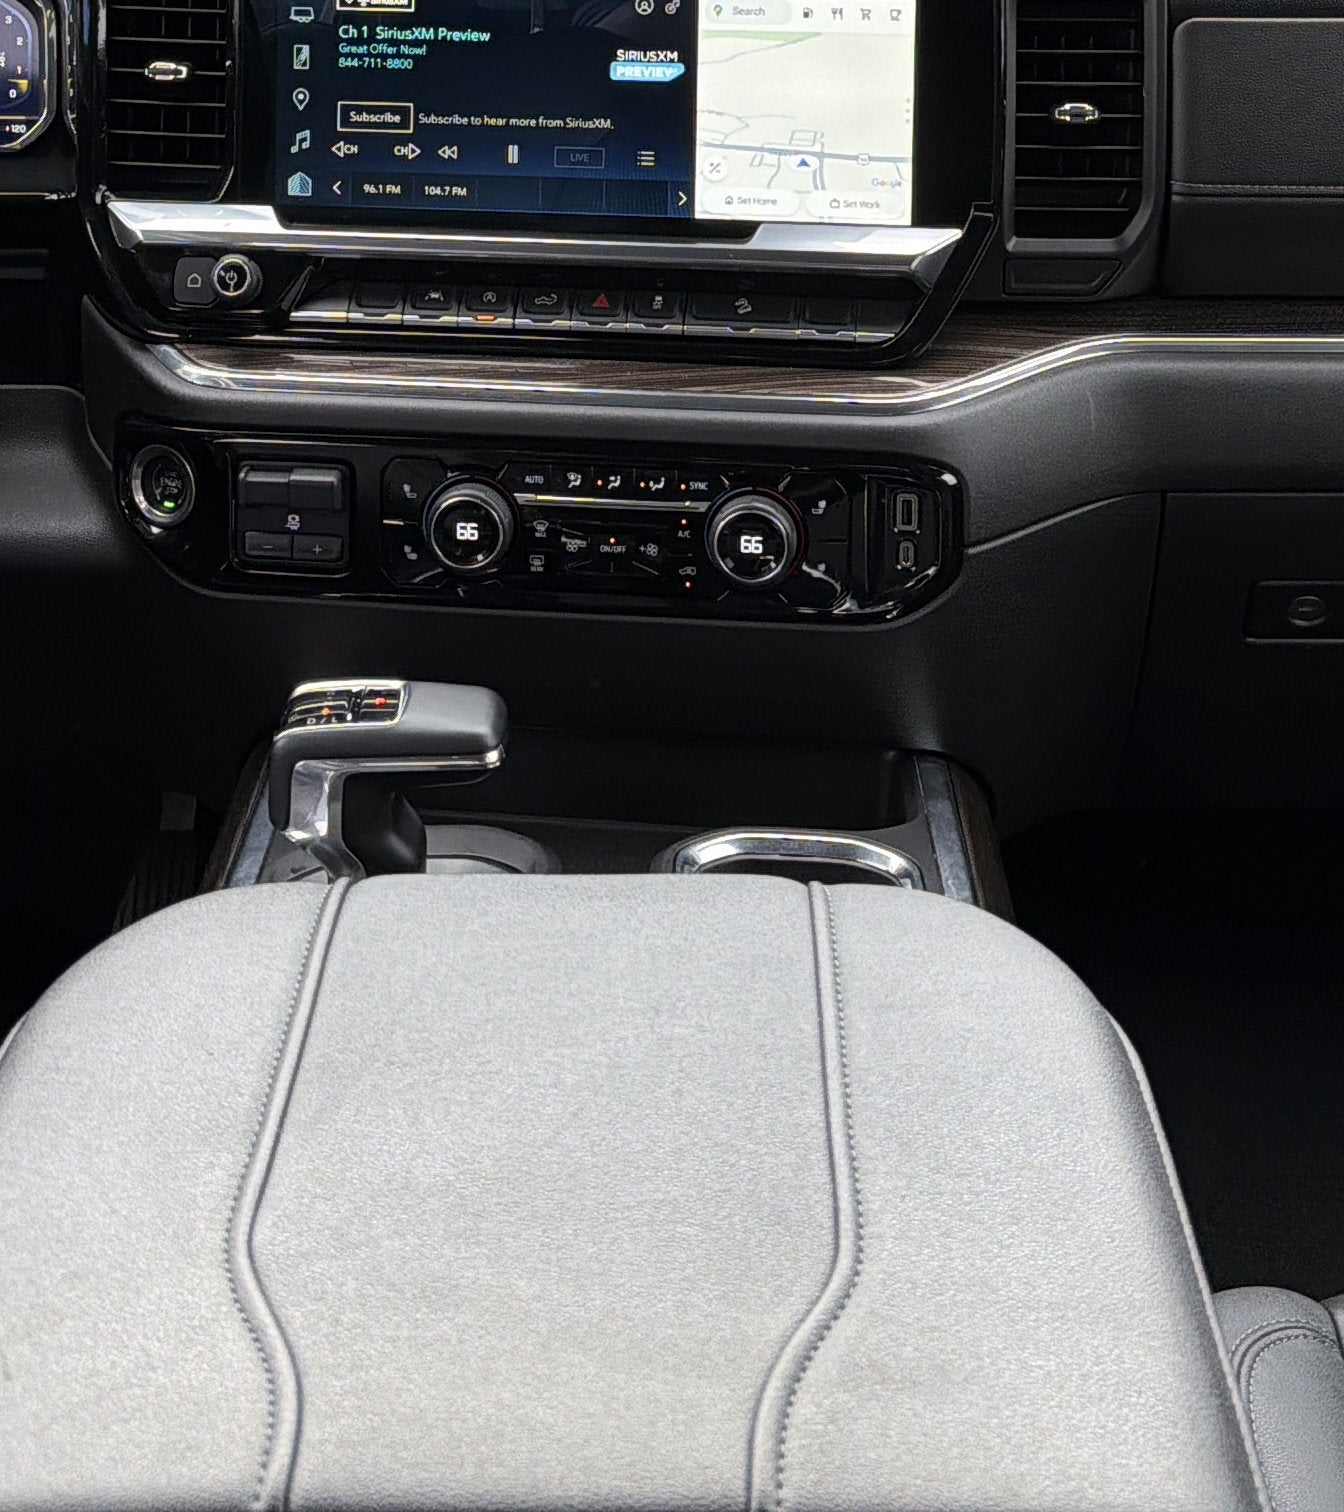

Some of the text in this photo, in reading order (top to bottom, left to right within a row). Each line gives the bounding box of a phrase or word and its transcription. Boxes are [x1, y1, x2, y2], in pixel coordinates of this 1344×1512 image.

[732, 6, 766, 17] Search
[4, 14, 13, 25] 3
[338, 25, 491, 42] Ch 1 SiriusXM Preview
[16, 36, 24, 46] 2
[338, 43, 427, 56] Great Offer Now!
[616, 49, 678, 63] SIRIUSXM
[338, 56, 413, 70] 844-711-8800
[17, 65, 23, 75] 1
[615, 66, 674, 79] PREVIEW
[349, 111, 401, 124] Subscribe
[418, 113, 615, 131] Subscribe to hear more from SiriusXM.
[11, 123, 27, 133] 120
[344, 144, 358, 155] CH
[394, 145, 408, 156] CH
[570, 153, 589, 163] LIVE
[363, 184, 401, 194] 96.1 FM
[424, 185, 467, 197] 104.7 FM
[737, 195, 778, 206] Set Home
[843, 199, 881, 209] Set Work
[524, 475, 544, 485] AUTO
[688, 481, 709, 491] SYNC
[456, 522, 479, 541] 66
[677, 529, 691, 538] A/C
[599, 544, 627, 554] ON/OFF
[740, 534, 764, 554] 66
